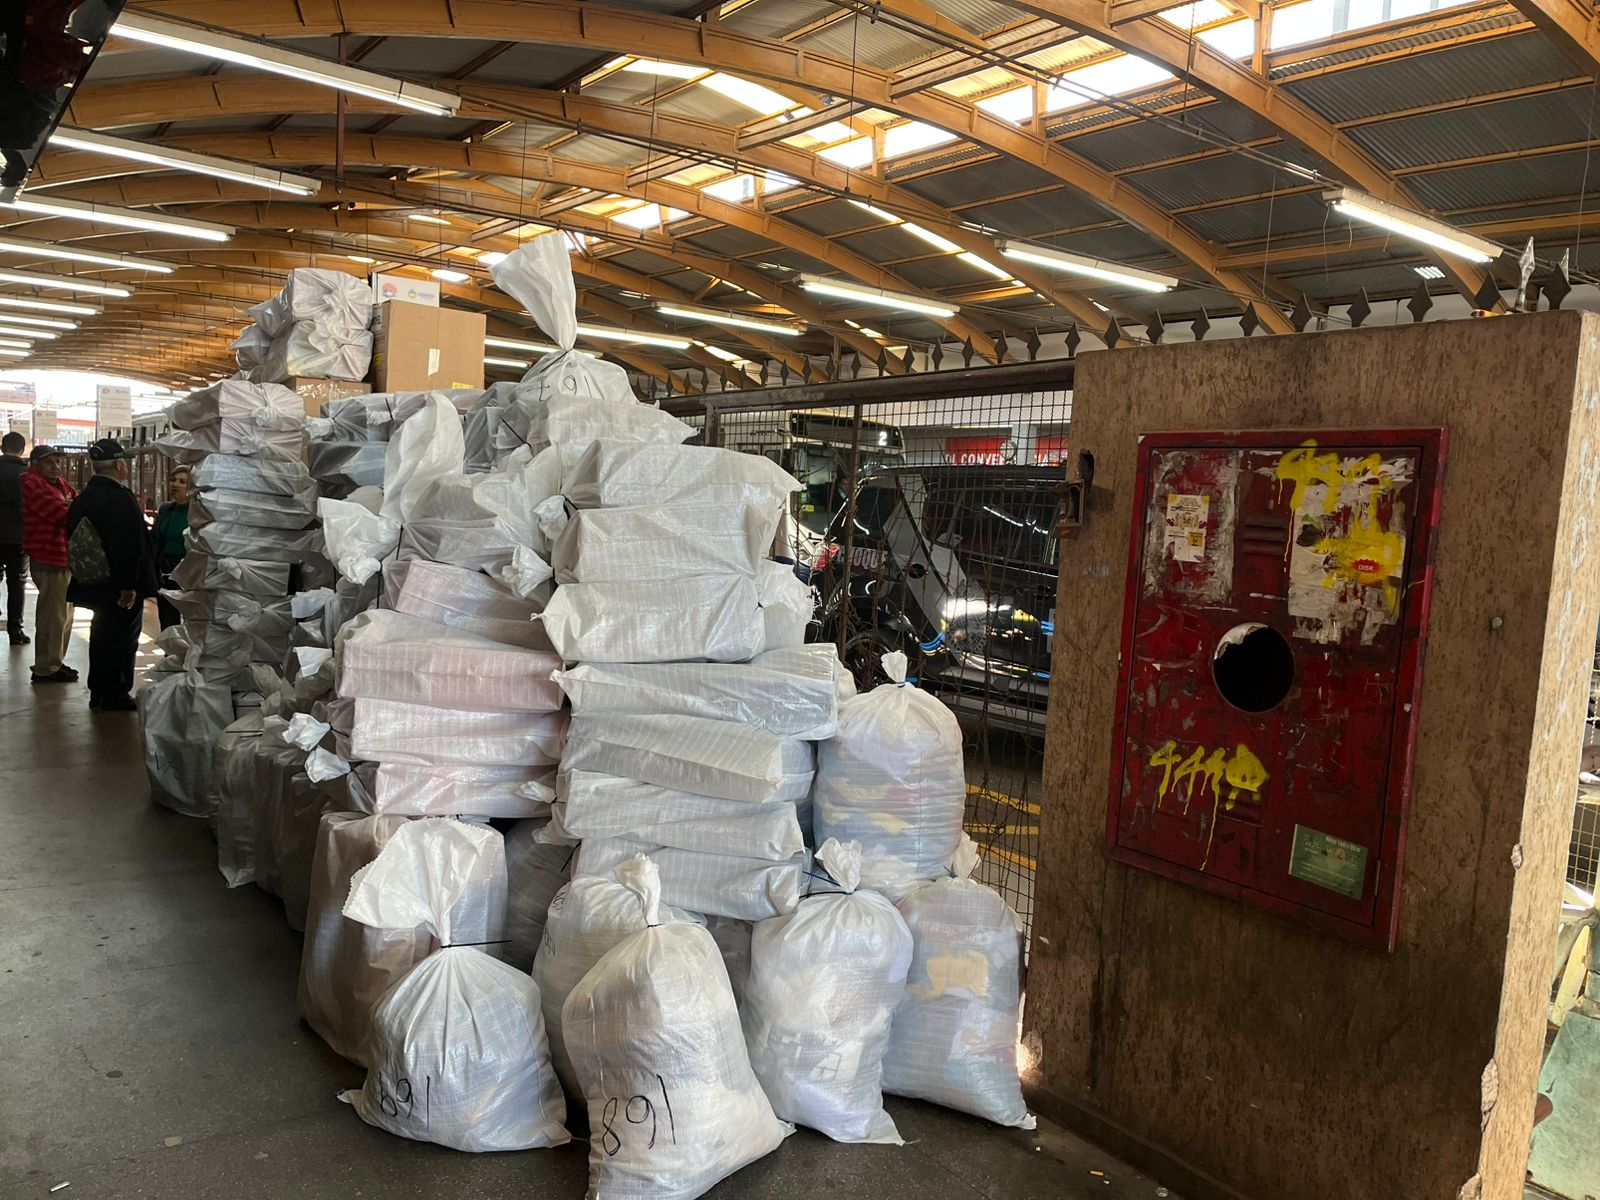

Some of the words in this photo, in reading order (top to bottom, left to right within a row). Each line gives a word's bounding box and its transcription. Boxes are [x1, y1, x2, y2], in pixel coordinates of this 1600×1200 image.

[878, 430, 888, 446] 2
[1357, 562, 1375, 572] DISK
[601, 1073, 677, 1156] 891
